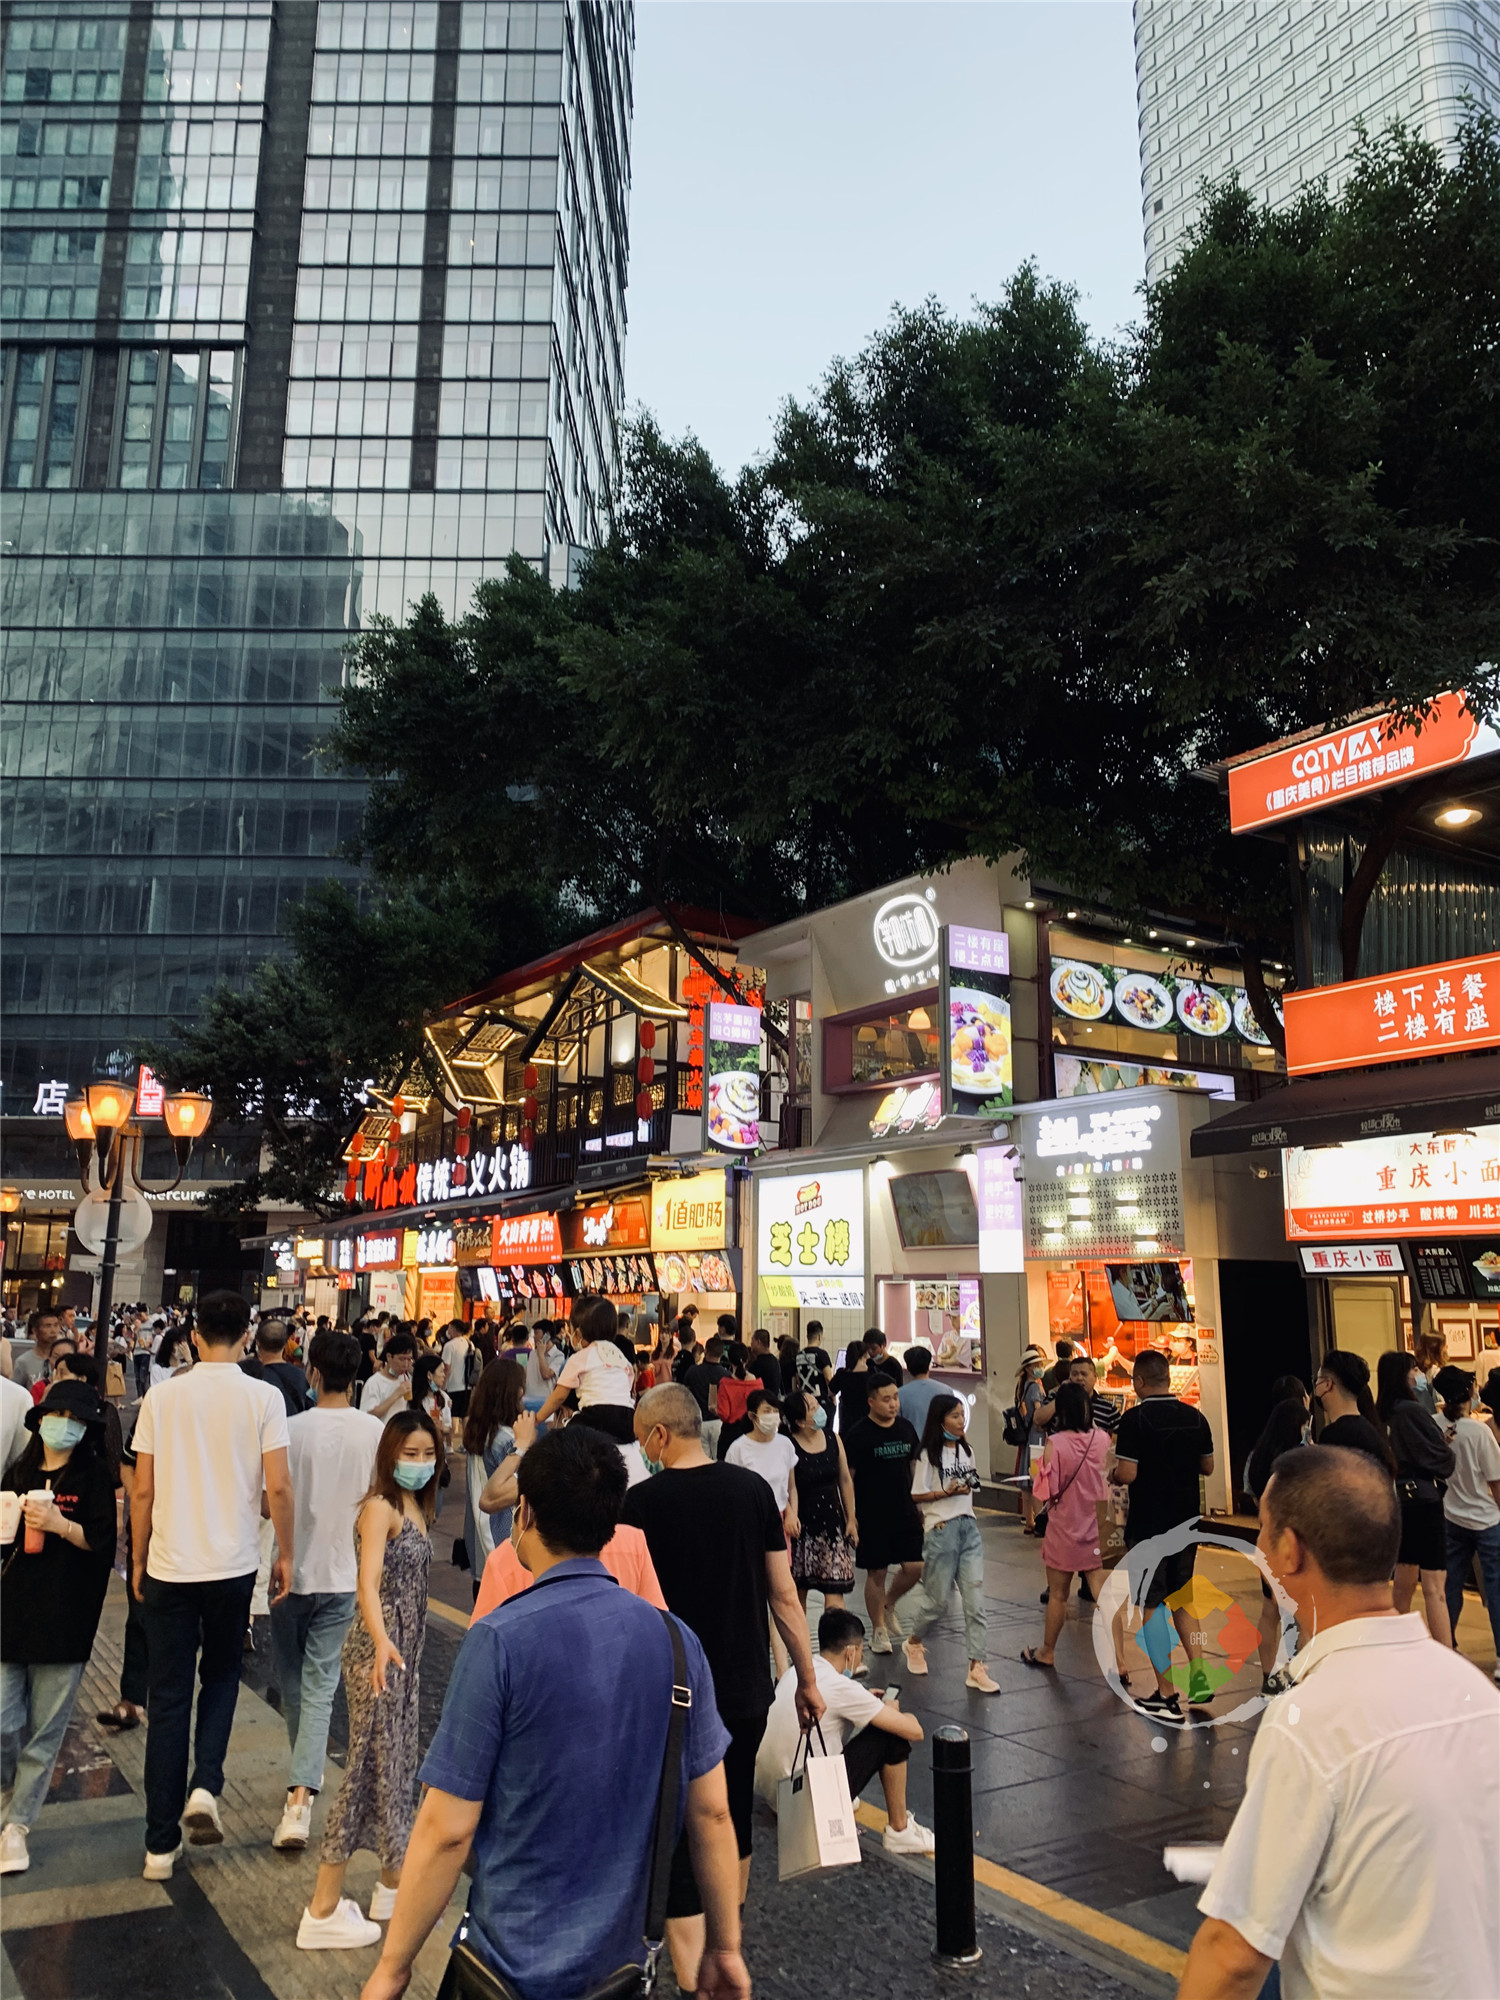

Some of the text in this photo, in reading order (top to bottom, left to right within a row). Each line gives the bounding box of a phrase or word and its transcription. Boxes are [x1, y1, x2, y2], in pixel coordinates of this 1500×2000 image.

[1292, 737, 1347, 779] CQTV
[1266, 745, 1415, 812] 《重庆美食》栏目推荐品牌
[954, 933, 1004, 953] 二楼有座
[954, 949, 1005, 968] 楼上点单
[1373, 972, 1487, 1017] 楼下点餐
[1377, 1003, 1490, 1043] 二楼有座
[33, 1081, 69, 1115] 店
[1409, 1138, 1474, 1156] 大东匠人
[1376, 1158, 1500, 1191] 重庆小面
[38, 1189, 76, 1200] HOTEL
[1362, 1208, 1411, 1224] 过桥抄手
[1420, 1204, 1458, 1221] 酸辣粉
[770, 1219, 850, 1267] 芝士棒
[1312, 1249, 1394, 1269] 重庆小面
